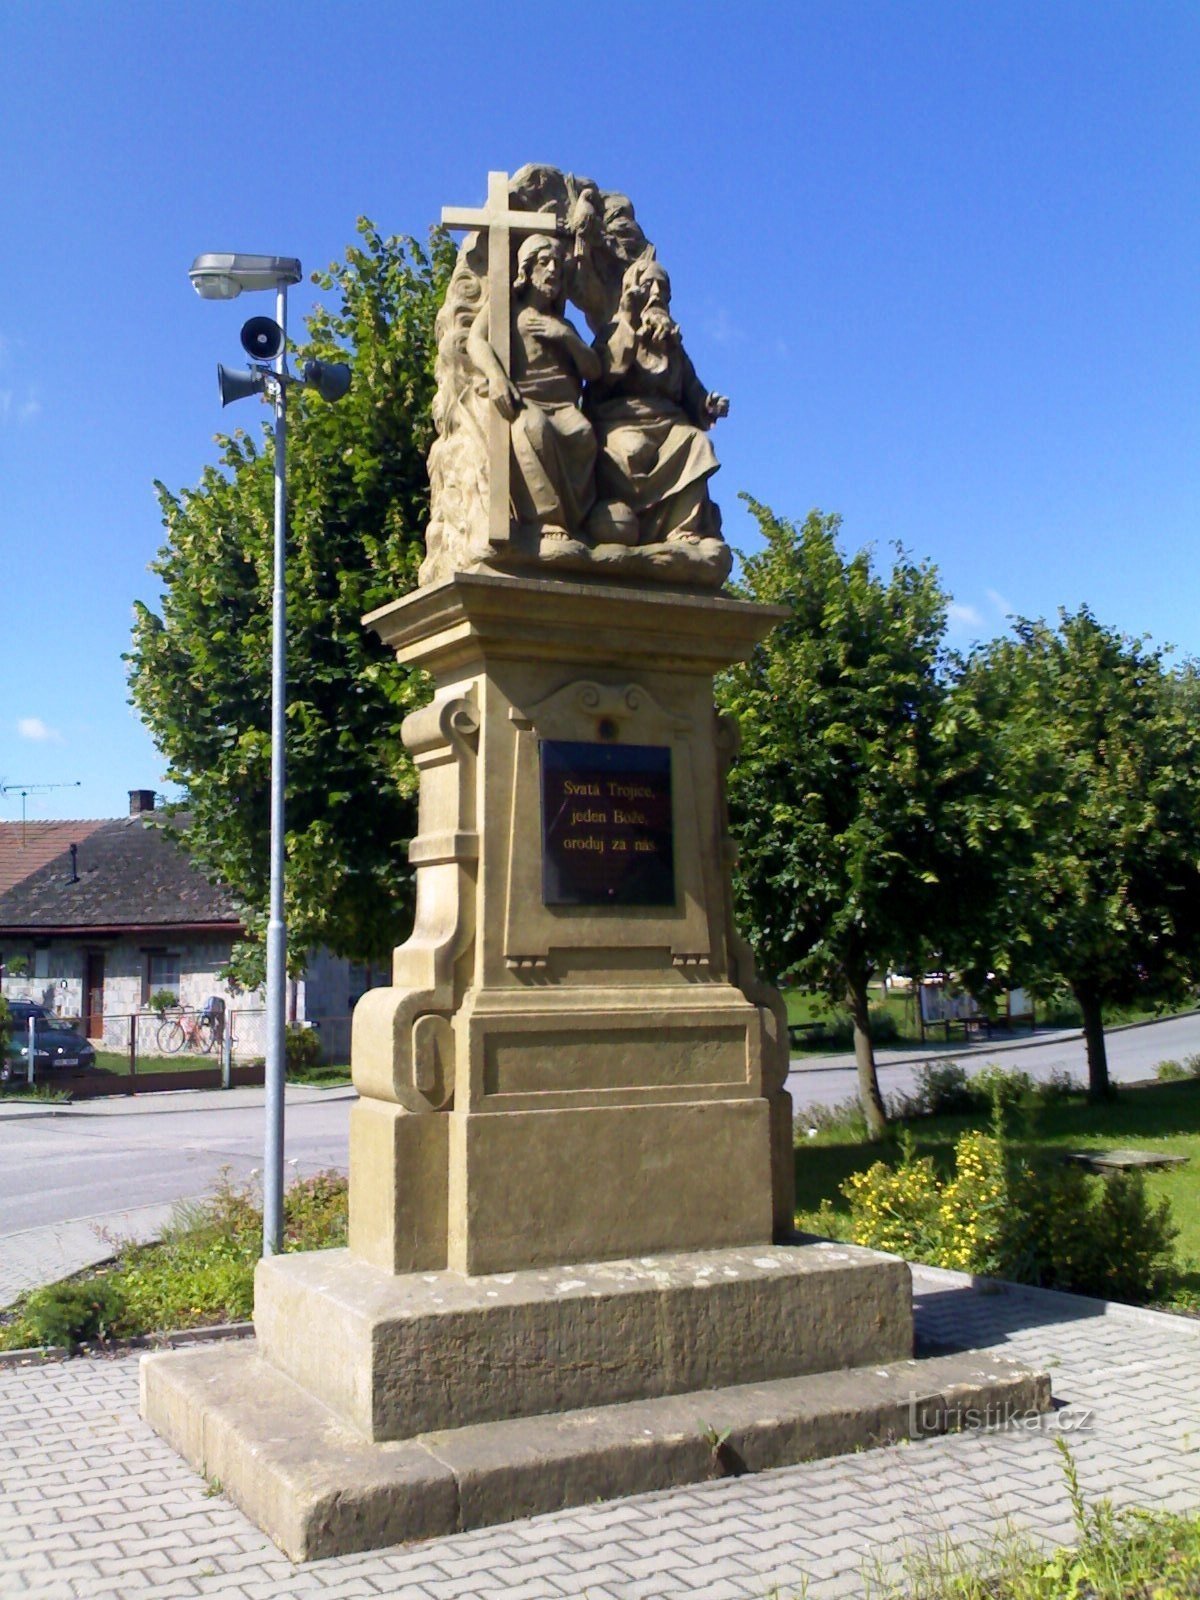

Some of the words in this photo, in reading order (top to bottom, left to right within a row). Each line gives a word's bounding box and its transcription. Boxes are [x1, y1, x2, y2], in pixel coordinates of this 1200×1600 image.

[571, 809, 607, 825] jeden
[563, 836, 604, 853] oroduj
[612, 840, 627, 850] za
